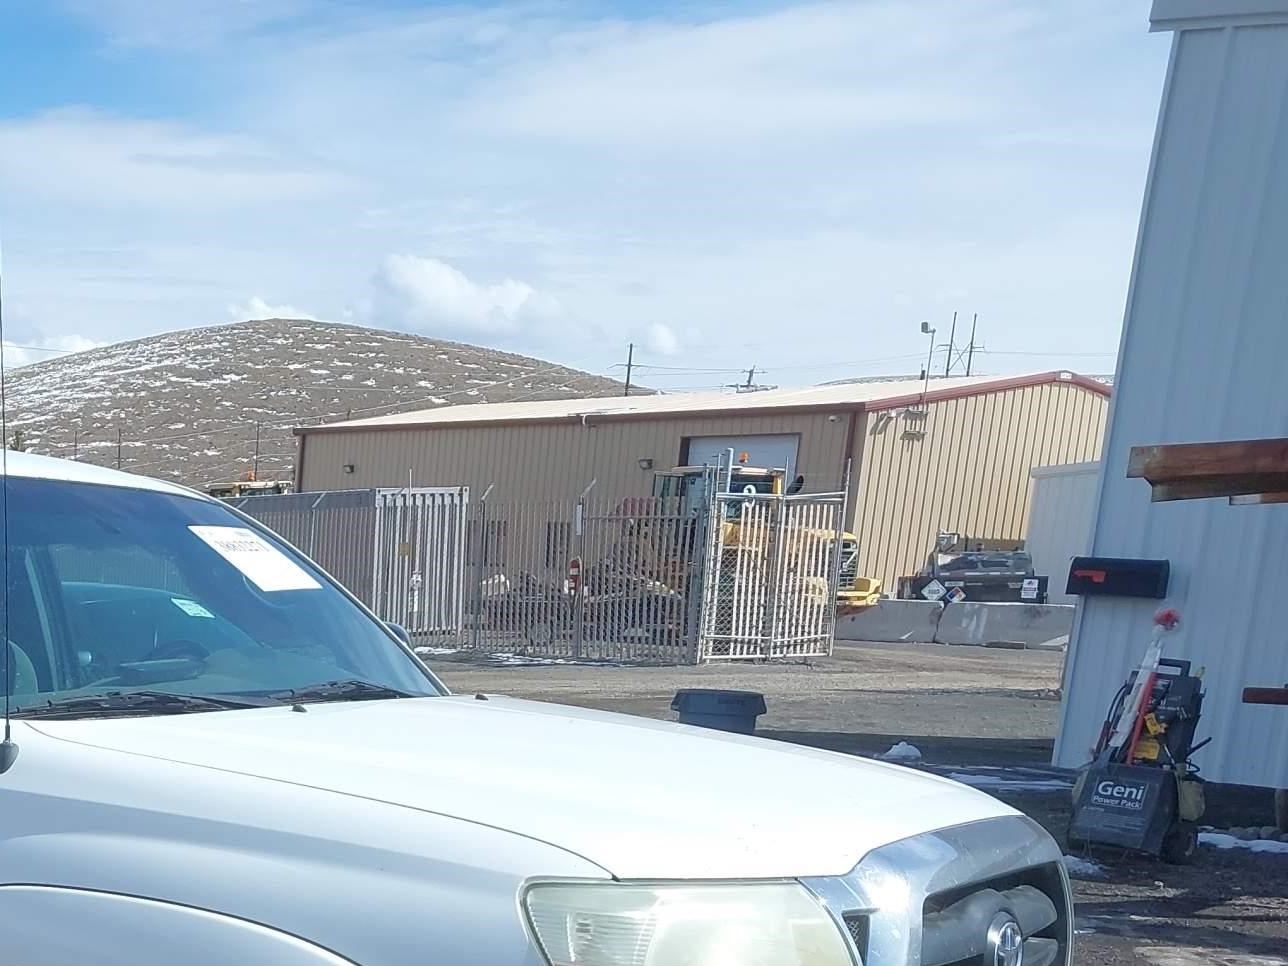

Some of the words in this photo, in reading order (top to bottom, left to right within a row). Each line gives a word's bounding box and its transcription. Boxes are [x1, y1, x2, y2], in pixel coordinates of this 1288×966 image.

[1097, 780, 1145, 800] Geni
[1093, 795, 1120, 806] Power
[1120, 799, 1142, 809] Pack
